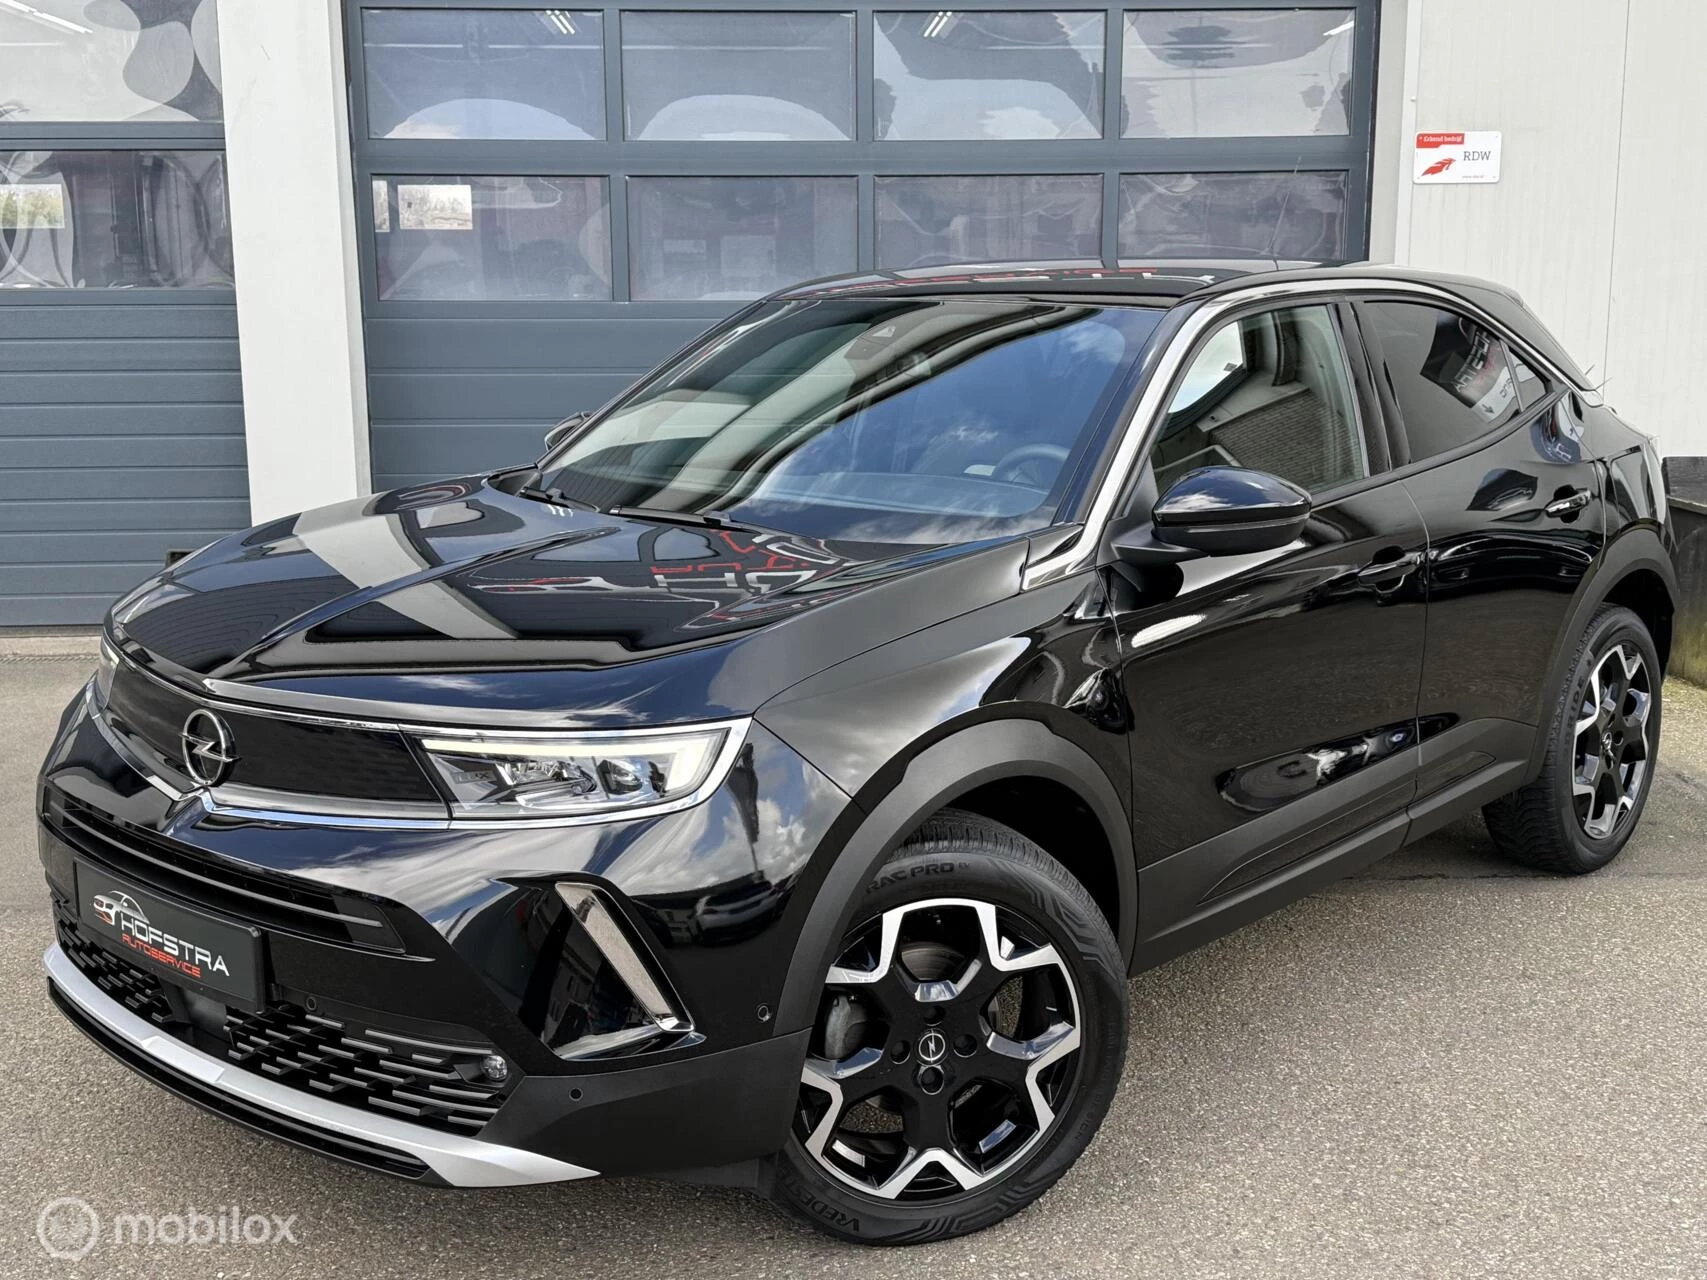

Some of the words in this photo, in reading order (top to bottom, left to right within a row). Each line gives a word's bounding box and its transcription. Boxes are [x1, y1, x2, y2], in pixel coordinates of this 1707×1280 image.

[1463, 151, 1492, 161] RDW
[865, 870, 907, 895] RAC
[910, 862, 955, 878] PRO
[120, 911, 230, 977] HOFSTRA
[121, 933, 201, 979] AUTOSERVICE
